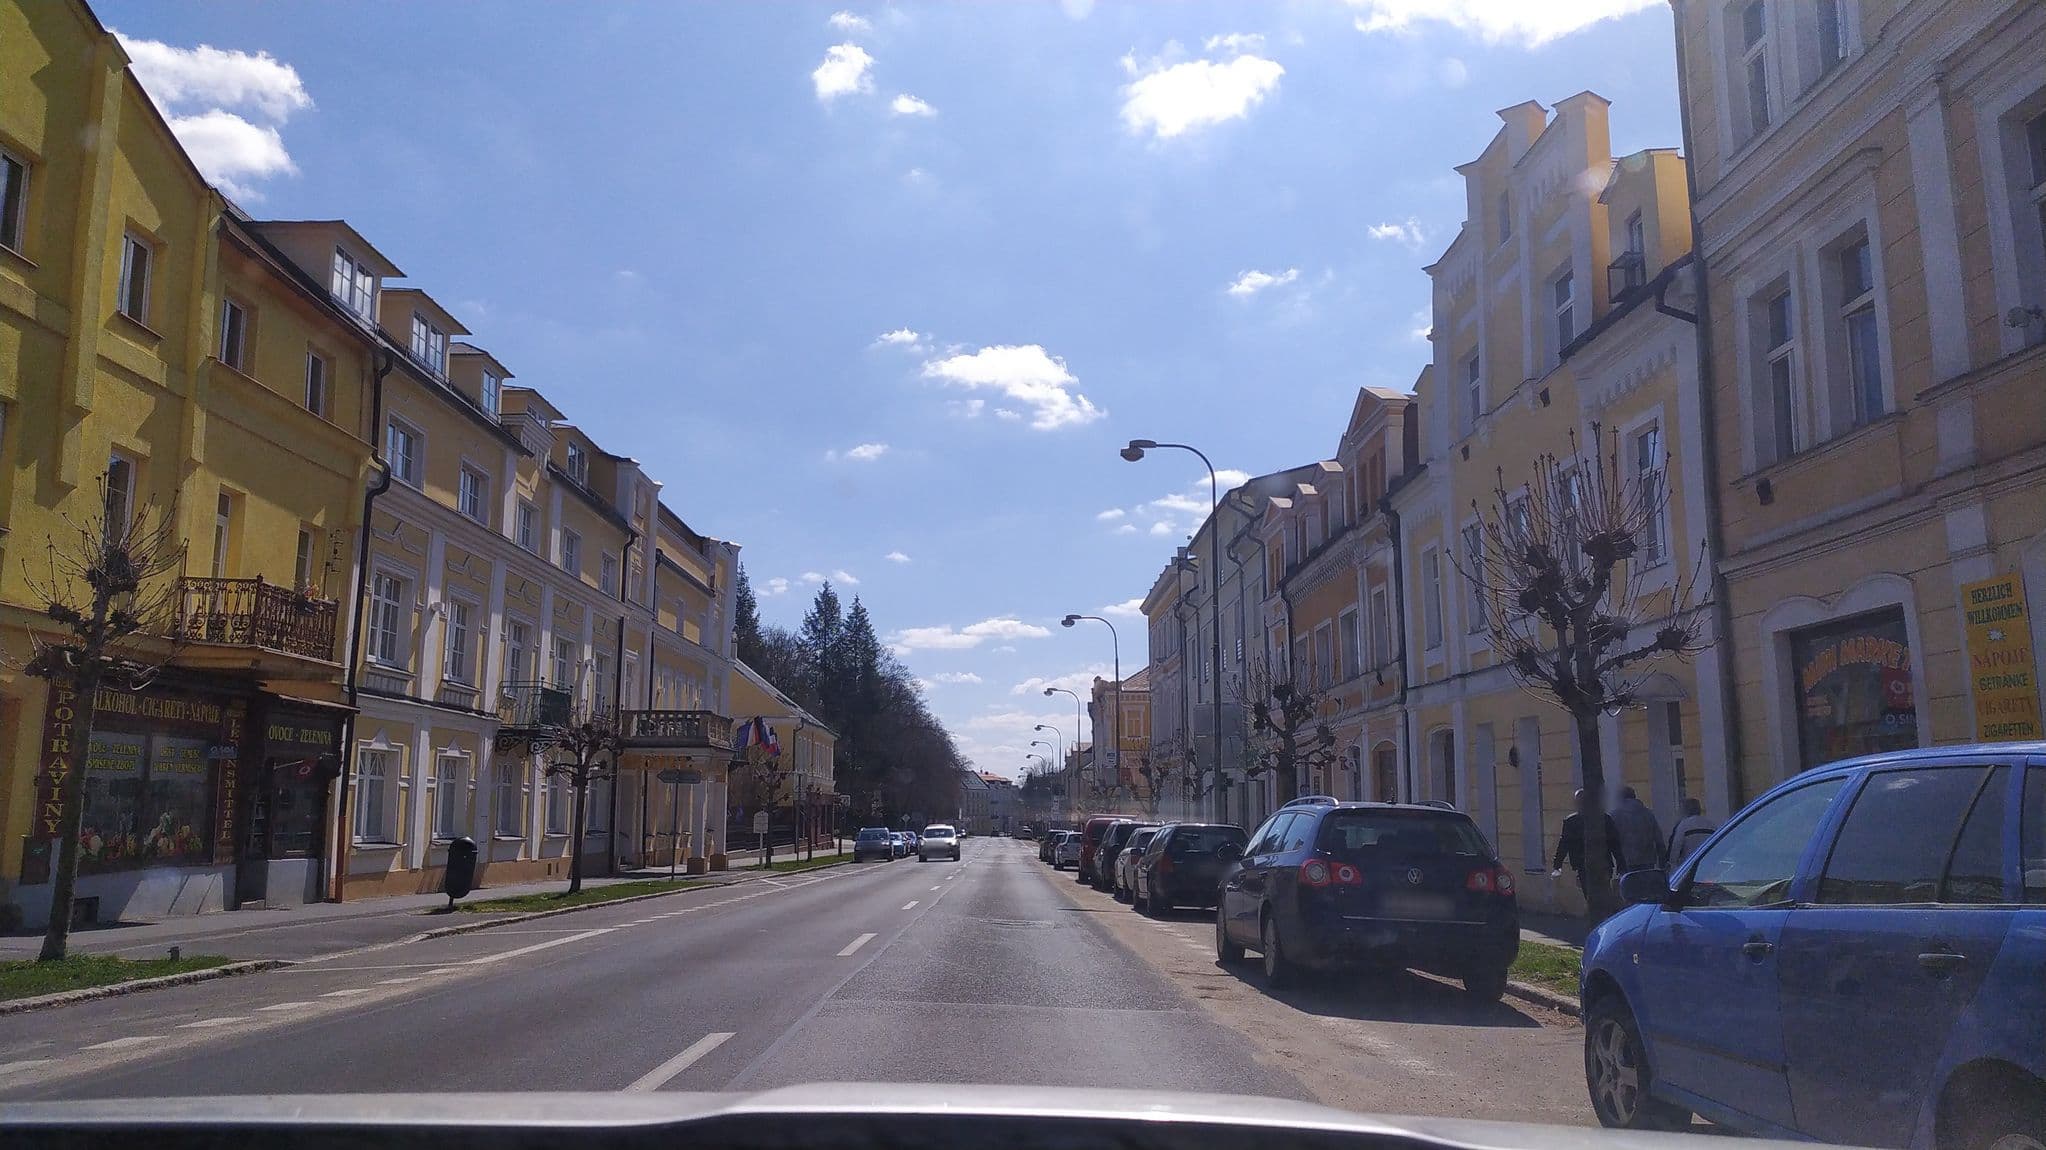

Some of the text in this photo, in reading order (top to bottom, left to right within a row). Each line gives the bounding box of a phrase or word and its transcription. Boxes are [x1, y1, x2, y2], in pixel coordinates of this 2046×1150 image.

[1971, 582, 2013, 605] HERZLICH
[1967, 602, 2023, 626] WILLKOMMEN
[92, 691, 137, 715] ALKOHOL
[268, 725, 332, 745] OVOCE ZELENINA
[1984, 722, 2034, 738] ZIGARETTEN
[44, 692, 75, 833] POTRAVINY
